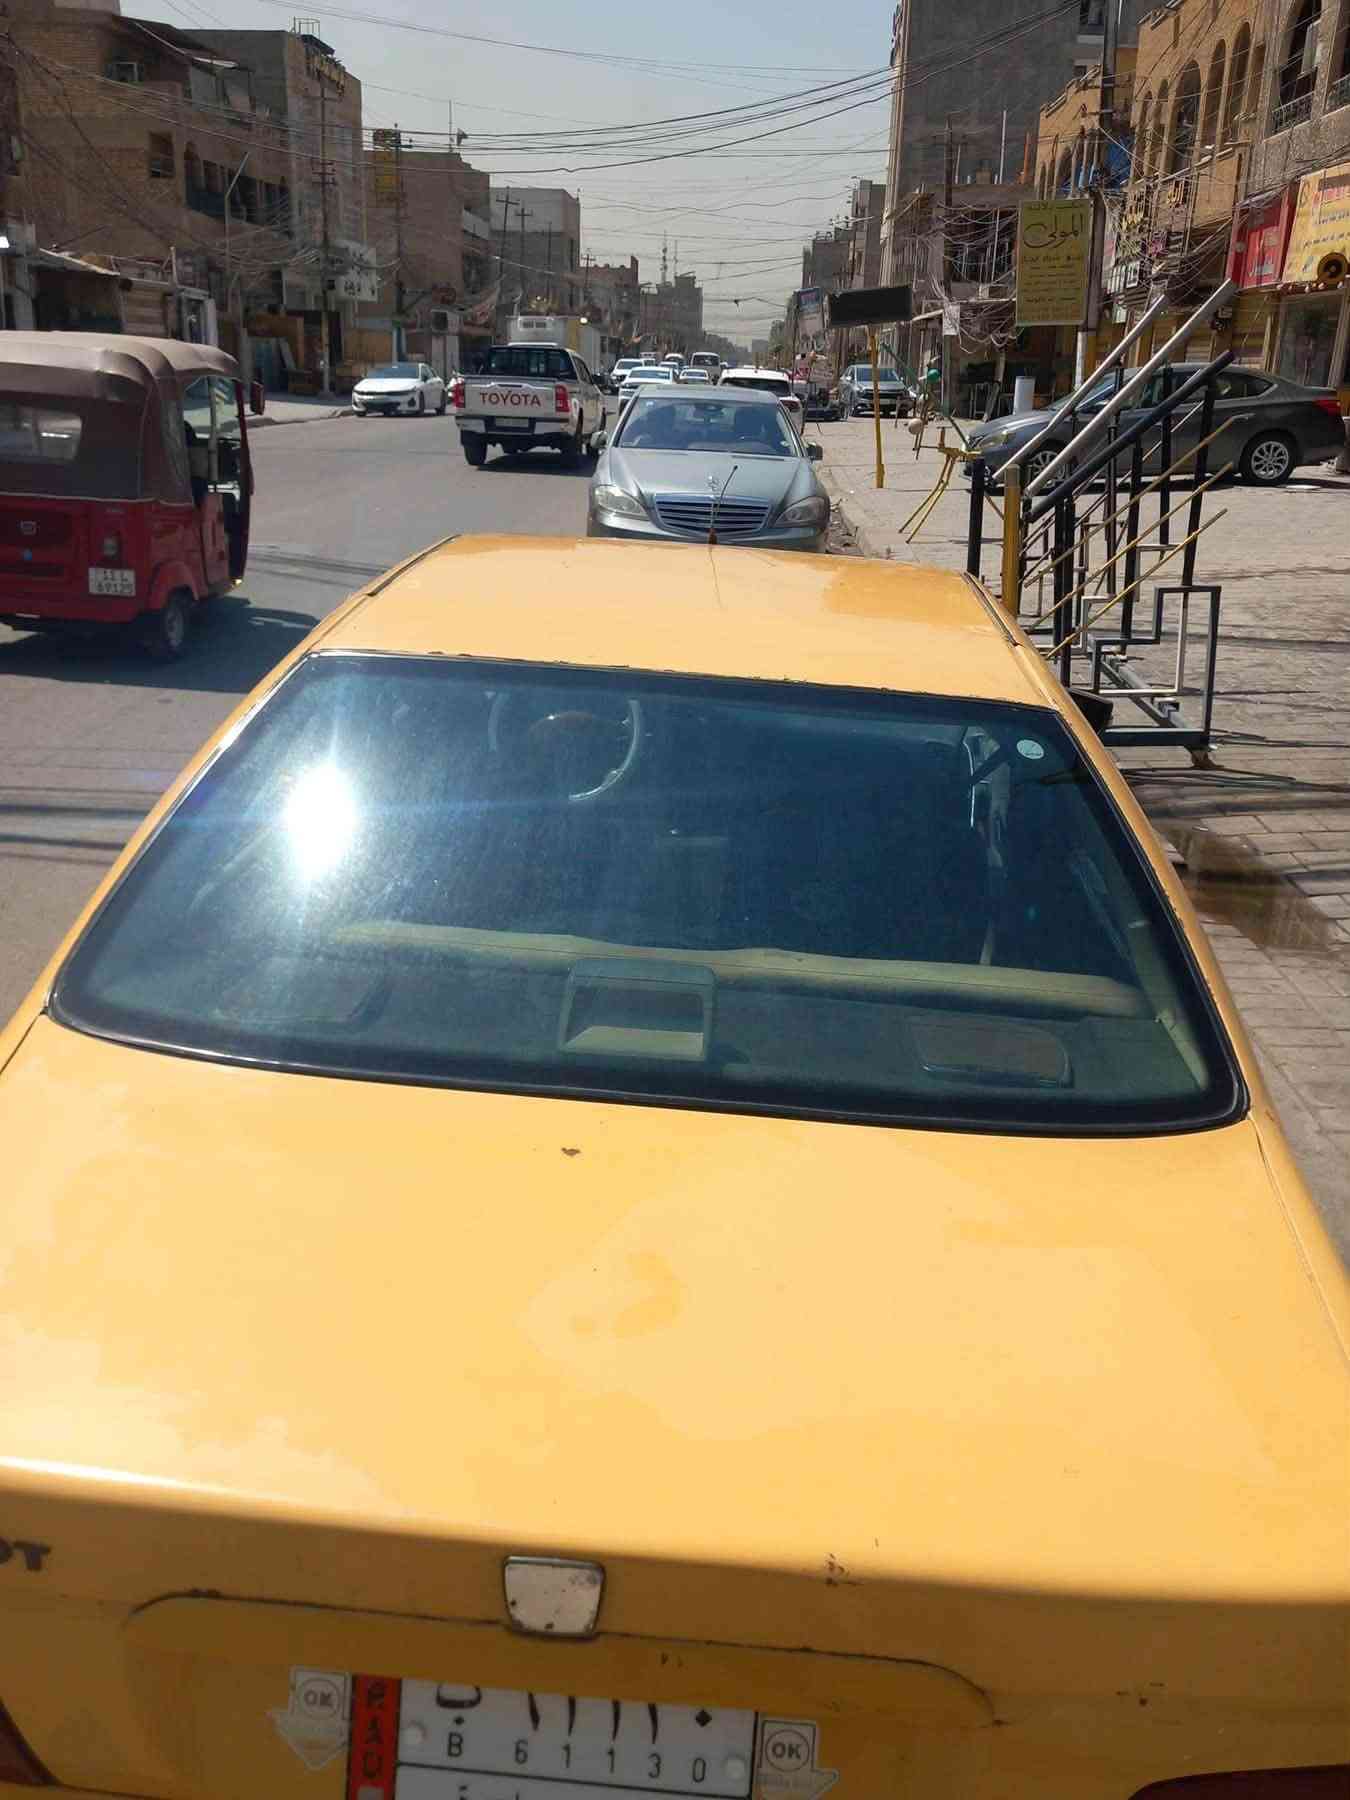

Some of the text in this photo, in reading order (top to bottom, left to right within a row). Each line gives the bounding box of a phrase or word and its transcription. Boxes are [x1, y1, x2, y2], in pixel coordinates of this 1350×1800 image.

[480, 391, 541, 406] TOYOTA
[303, 1689, 334, 1707] OK
[447, 1732, 706, 1782] B 61130
[771, 1742, 801, 1759] OK
